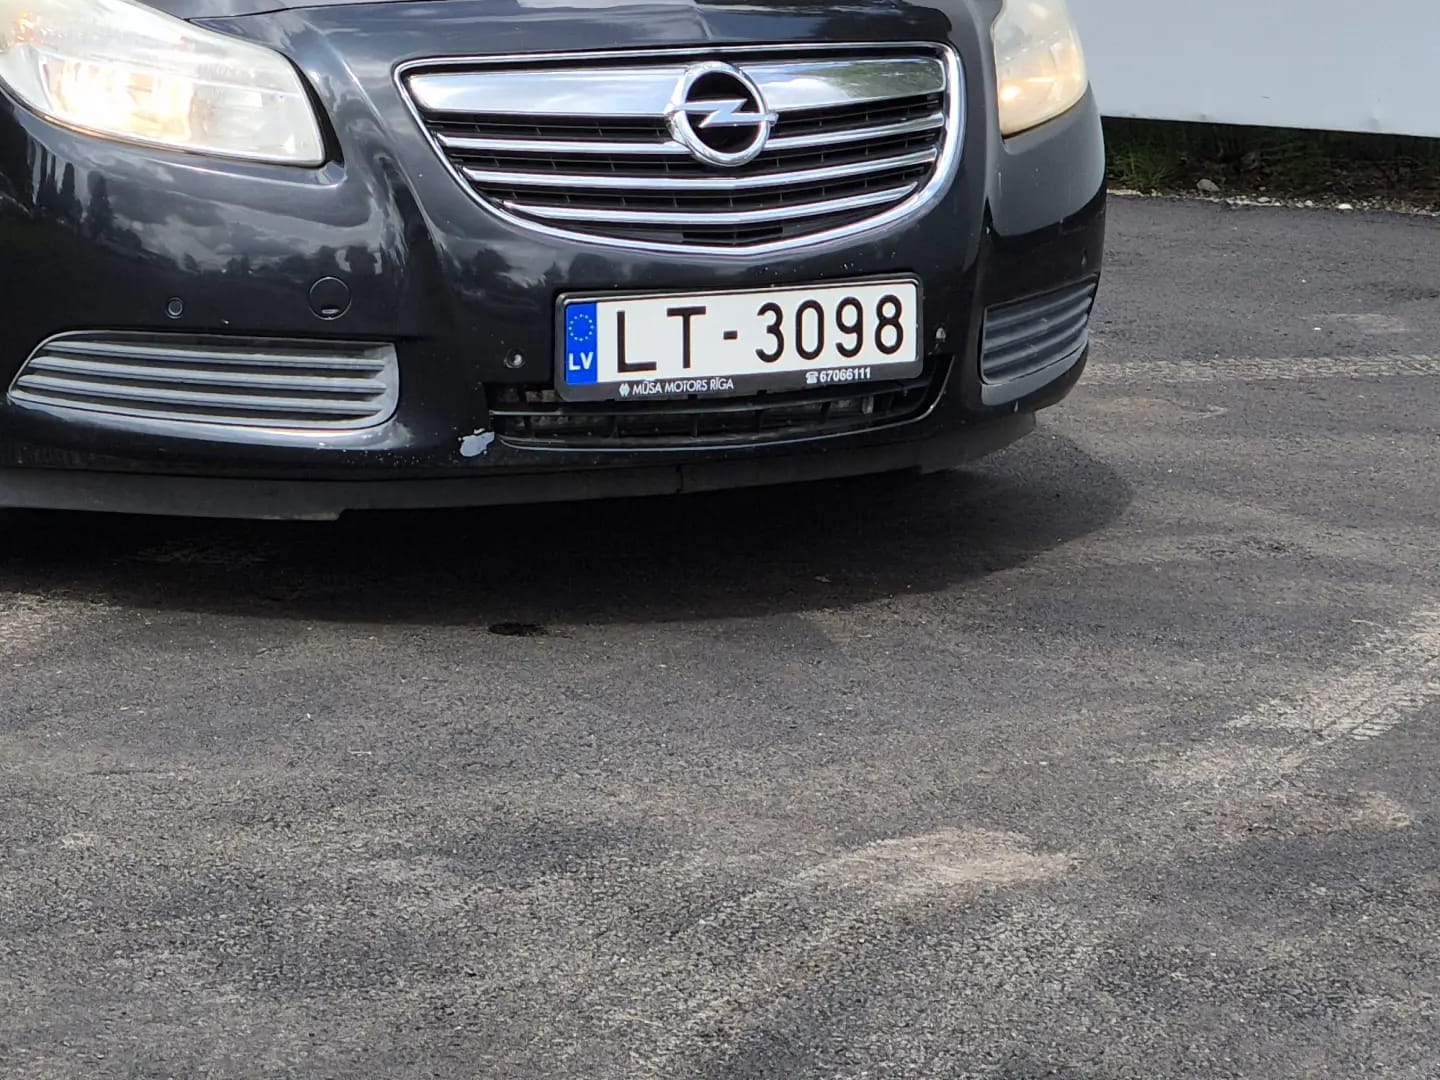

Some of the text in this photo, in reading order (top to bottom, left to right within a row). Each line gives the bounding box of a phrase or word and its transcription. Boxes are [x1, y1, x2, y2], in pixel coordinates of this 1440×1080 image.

[616, 294, 904, 373] LT-3098
[568, 351, 594, 370] LV
[820, 367, 871, 383] 67066111
[664, 379, 707, 393] MOTORS
